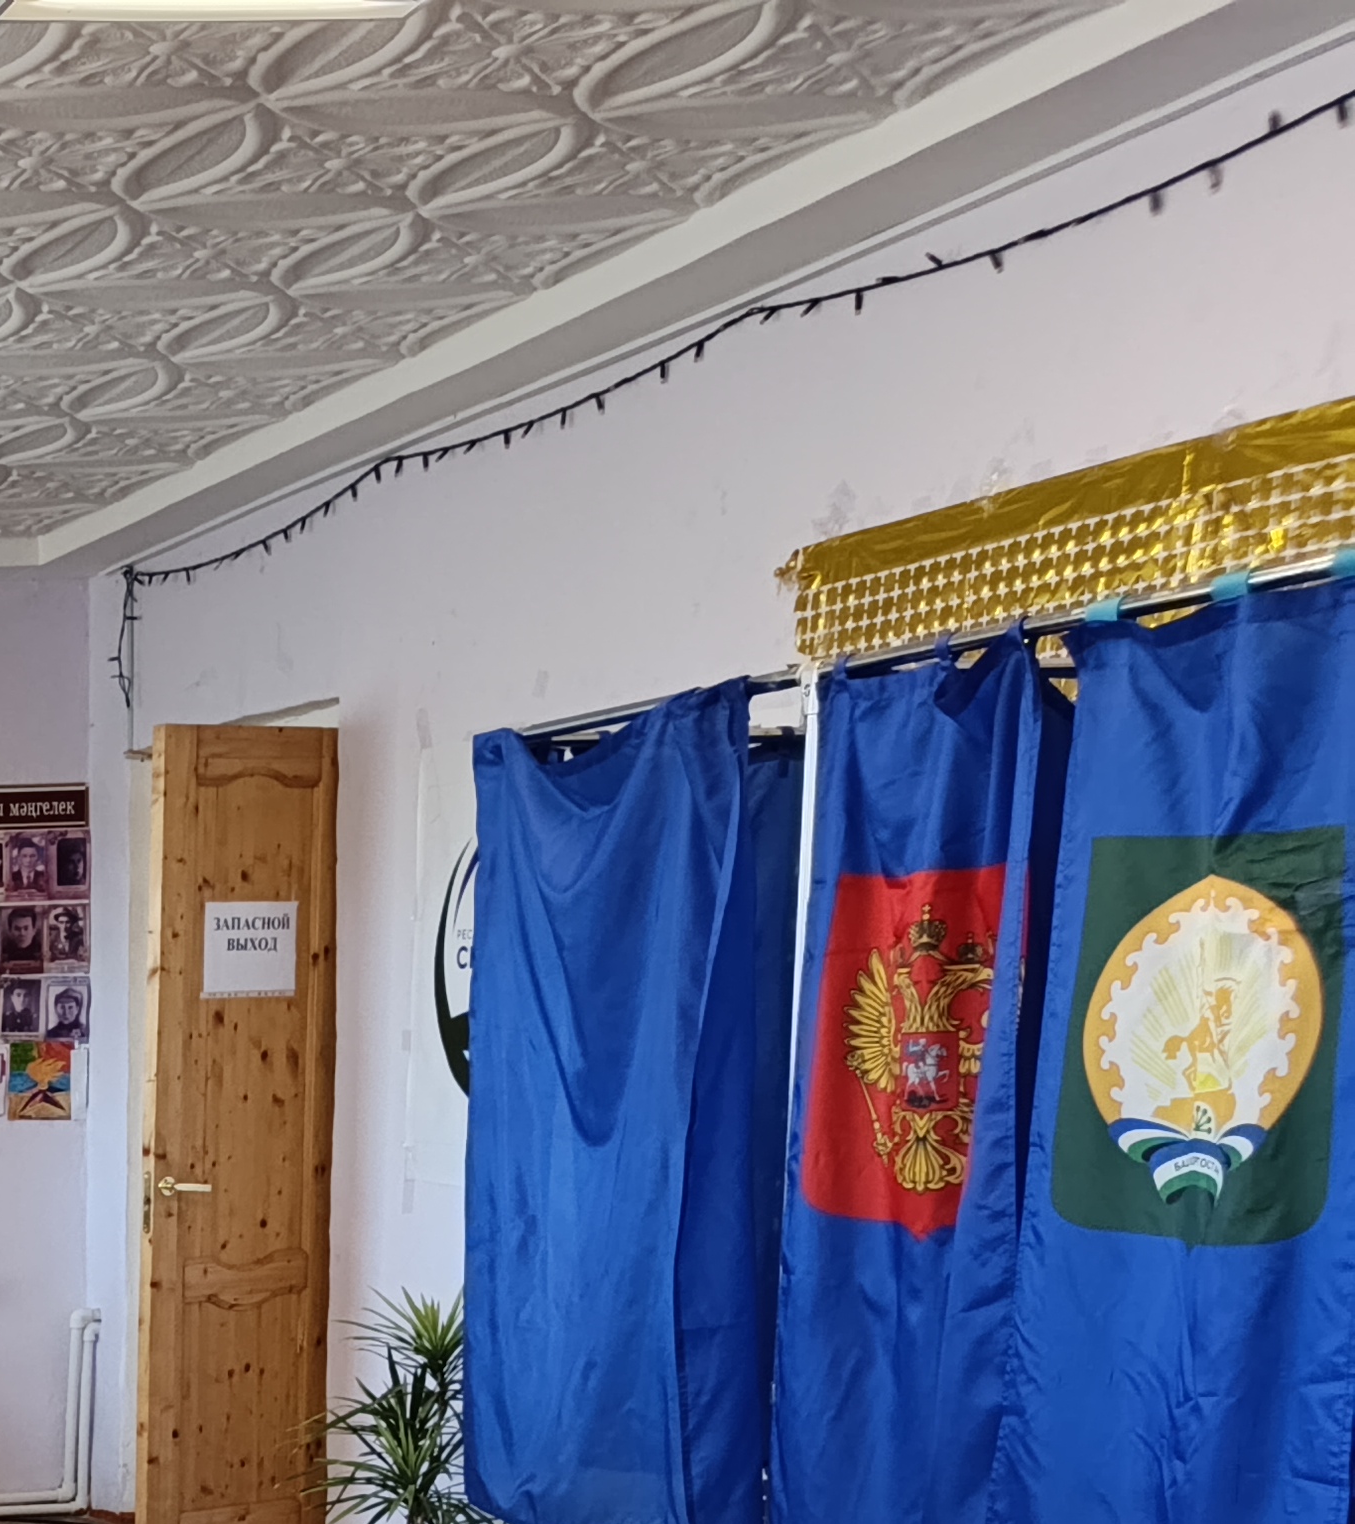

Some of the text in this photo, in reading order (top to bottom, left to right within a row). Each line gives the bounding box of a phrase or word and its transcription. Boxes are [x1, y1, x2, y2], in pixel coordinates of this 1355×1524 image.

[9, 800, 75, 818] мәңгелек
[213, 913, 290, 931] ЗАПАСНОЙ
[226, 937, 278, 952] ВЫХОД
